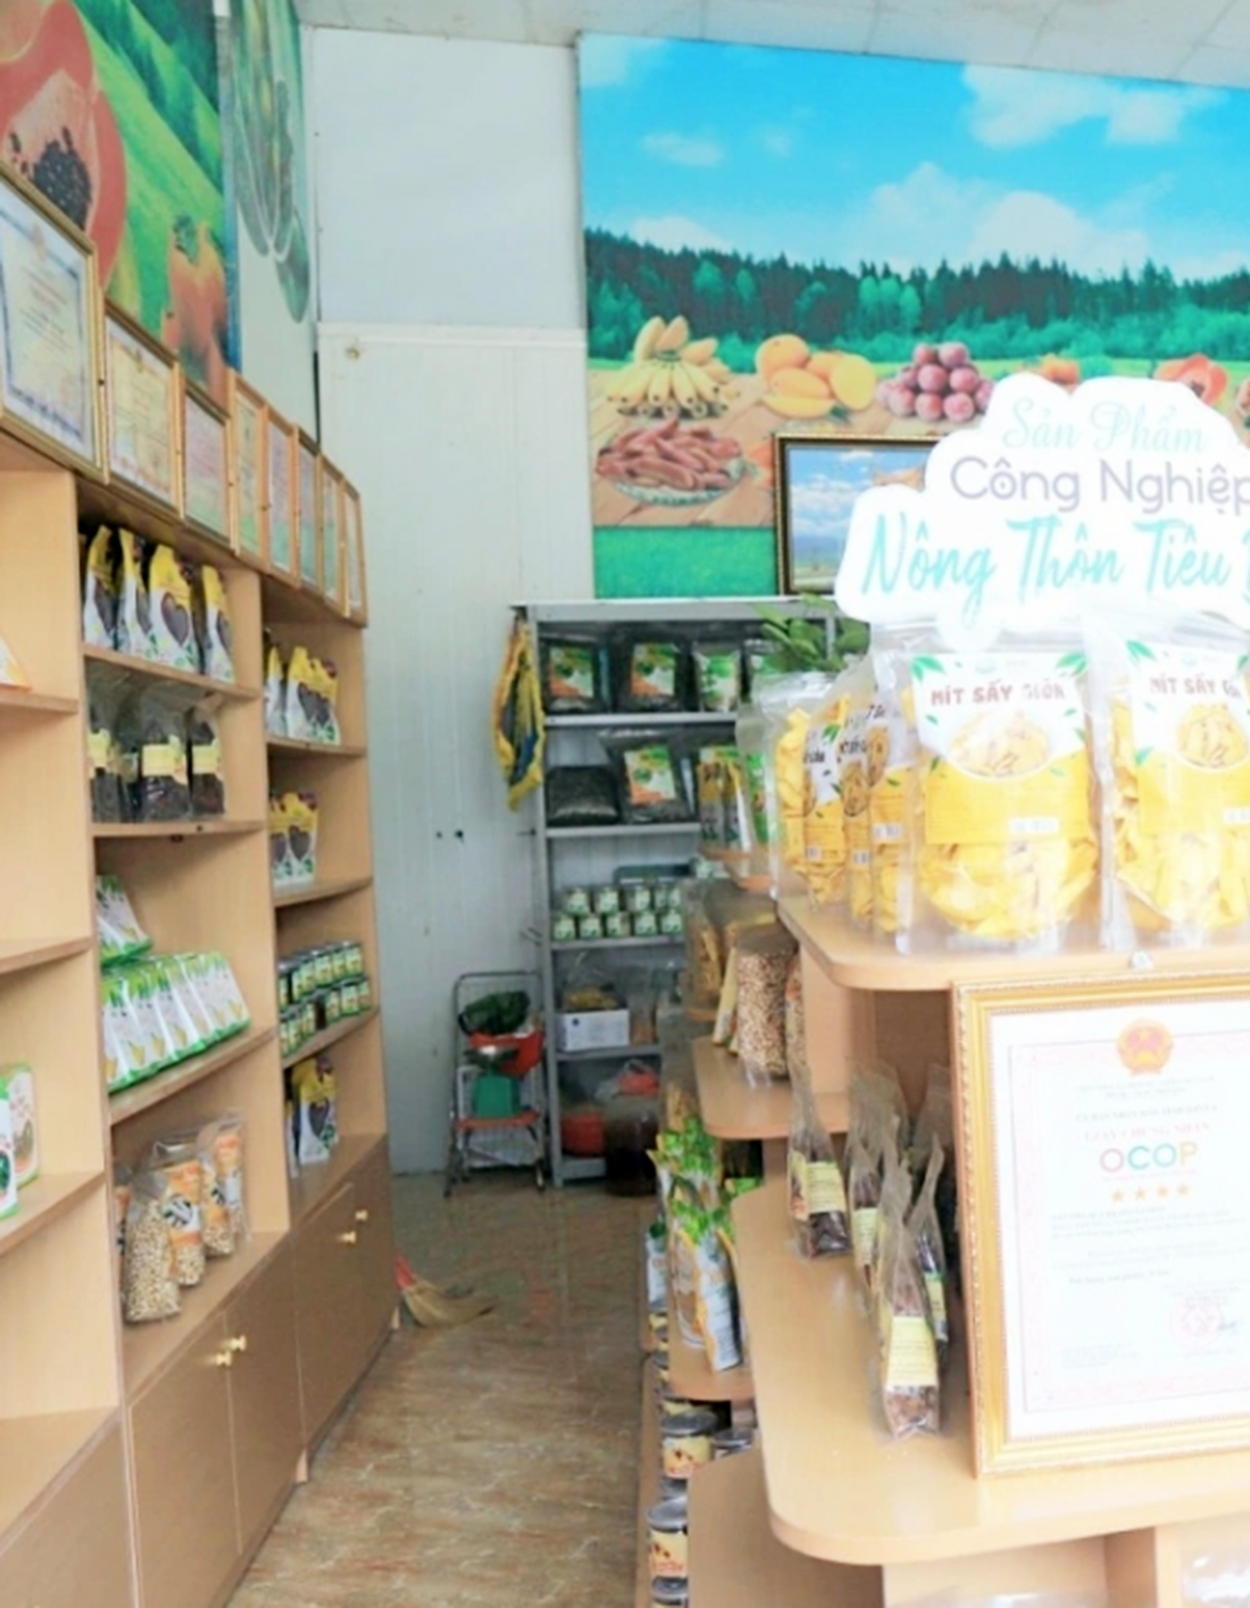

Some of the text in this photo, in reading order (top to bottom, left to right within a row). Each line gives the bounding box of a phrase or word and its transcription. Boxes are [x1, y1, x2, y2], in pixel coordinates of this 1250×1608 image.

[1002, 398, 1209, 453] Sản Phẩm
[950, 455, 1081, 512] Công
[861, 511, 996, 624] Nông
[1006, 512, 1125, 605] Thôn
[1132, 515, 1233, 600] Tiêu
[930, 684, 965, 706] MÍT
[972, 678, 1013, 704] SẤY
[1149, 673, 1178, 695] MÍT
[1183, 671, 1216, 695] SẤY
[1098, 1140, 1199, 1174] OCOP
